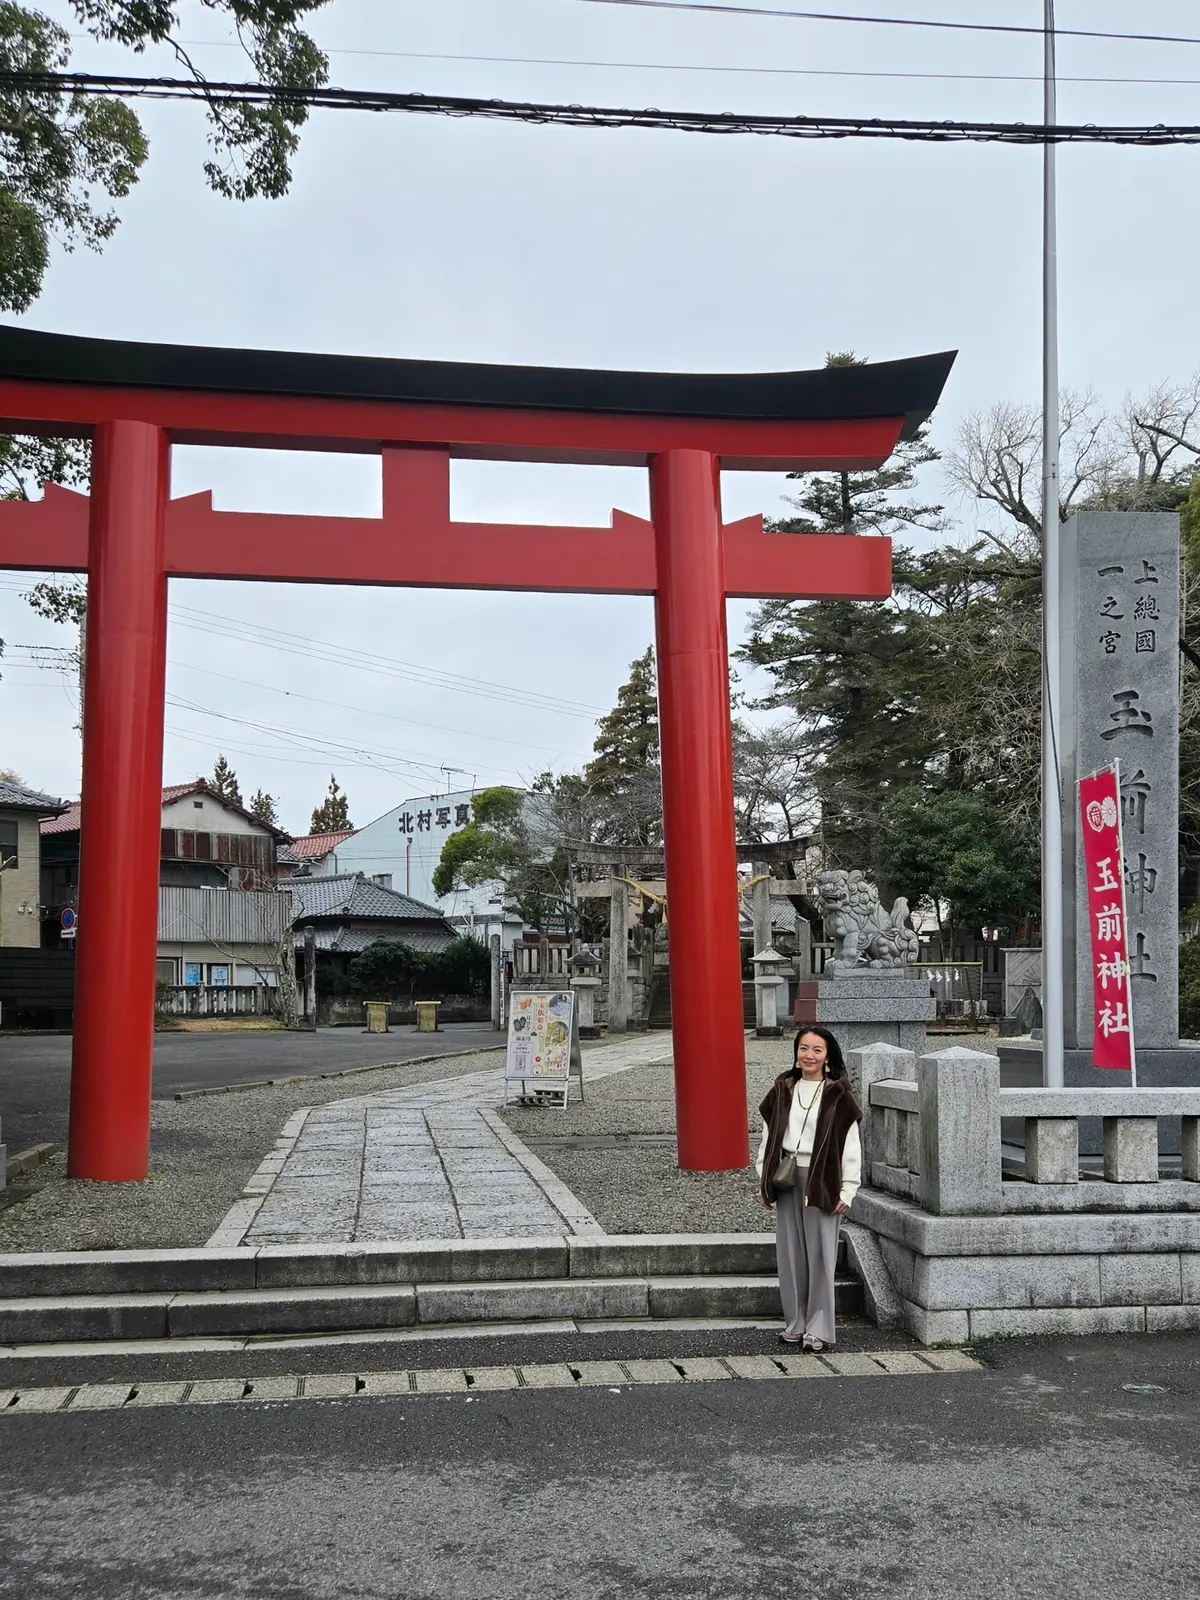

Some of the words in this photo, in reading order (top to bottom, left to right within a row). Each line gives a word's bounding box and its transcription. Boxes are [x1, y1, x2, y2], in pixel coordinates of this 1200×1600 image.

[1097, 564, 1125, 655] 一之宮
[1133, 559, 1161, 654] 上總國
[1092, 856, 1130, 1039] 玉前神社
